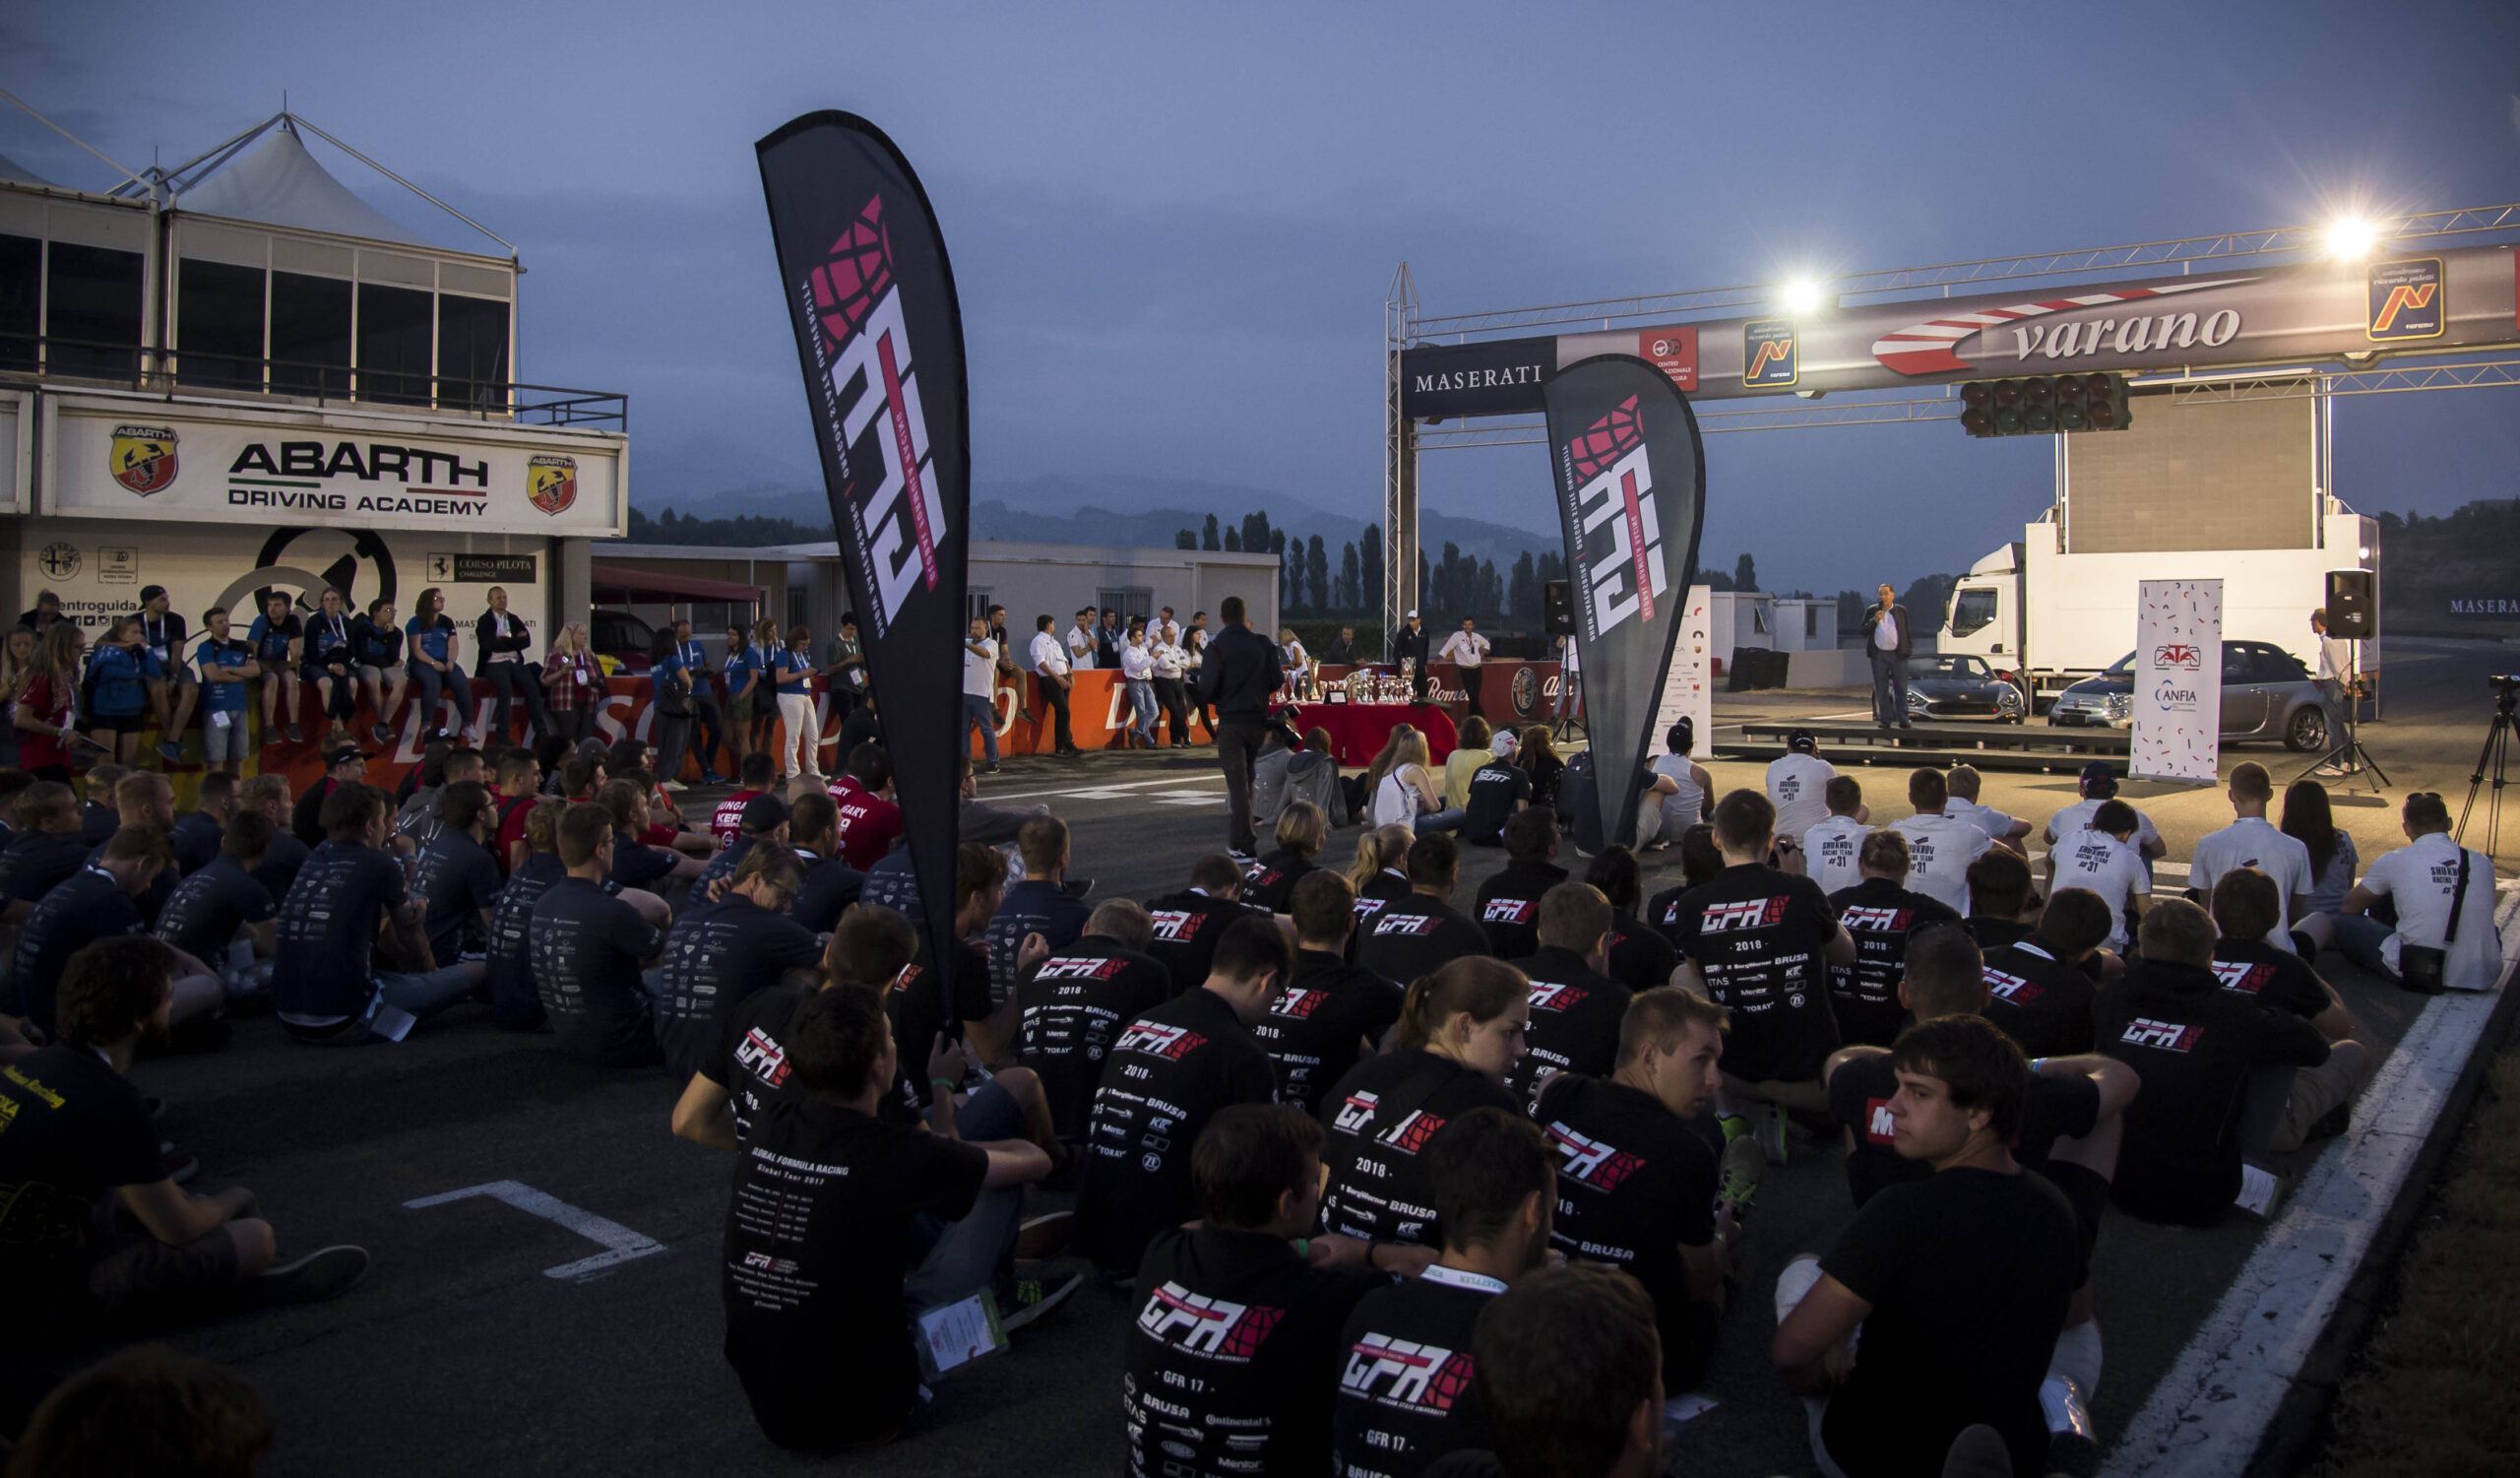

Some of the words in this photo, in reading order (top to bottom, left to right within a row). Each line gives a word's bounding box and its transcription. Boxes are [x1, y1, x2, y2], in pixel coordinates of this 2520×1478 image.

[2012, 308, 2241, 361] varano
[1415, 364, 1543, 393] MASERATI
[116, 426, 171, 440] ABARTH
[228, 441, 488, 487] ABARTH
[532, 456, 574, 468] ABARTH
[228, 489, 346, 510] DRIVING
[356, 495, 488, 516] ACADEMY
[459, 558, 492, 569] CORSO
[496, 560, 532, 571] PILOTA
[59, 600, 137, 613] entroguida
[2163, 689, 2197, 702] ANFIA
[1783, 792, 1795, 802] #31
[1828, 856, 1847, 868] #31
[1910, 862, 1927, 874] #31
[2079, 861, 2099, 873] #31
[1735, 939, 1762, 952] 2018
[1863, 940, 1887, 951] 2018
[1774, 952, 1809, 966] BRUSA
[1830, 965, 1852, 975] ETAS
[1707, 977, 1731, 988] ETAS
[1057, 986, 1082, 996] 2018
[1740, 987, 1768, 996] Mentor
[1084, 1004, 1119, 1021] BRUSA
[1255, 1025, 1280, 1040] 2018
[1283, 1053, 1321, 1066] BRUSA
[1531, 1047, 1571, 1066] BRUSA
[1124, 1063, 1150, 1080] 2018
[1146, 1097, 1188, 1121] BRUSA
[776, 1155, 815, 1172] FORMULA
[815, 1163, 850, 1177] RACING
[1354, 1156, 1387, 1179] 2018
[784, 1171, 802, 1183] Tour
[803, 1176, 826, 1187] 2017
[1346, 1185, 1388, 1206] BorgWarner
[1388, 1199, 1438, 1221] BRUSA
[1580, 1240, 1636, 1261] BRUSA
[1163, 1370, 1186, 1389] GFR
[1190, 1378, 1205, 1393] 17
[1123, 1393, 1148, 1426] ETAS
[1205, 1412, 1263, 1428] Continental
[1142, 1391, 1190, 1420] BRUSA
[1366, 1429, 1389, 1448] GFR
[1392, 1436, 1407, 1453] 17
[1216, 1455, 1263, 1470] Mentor
